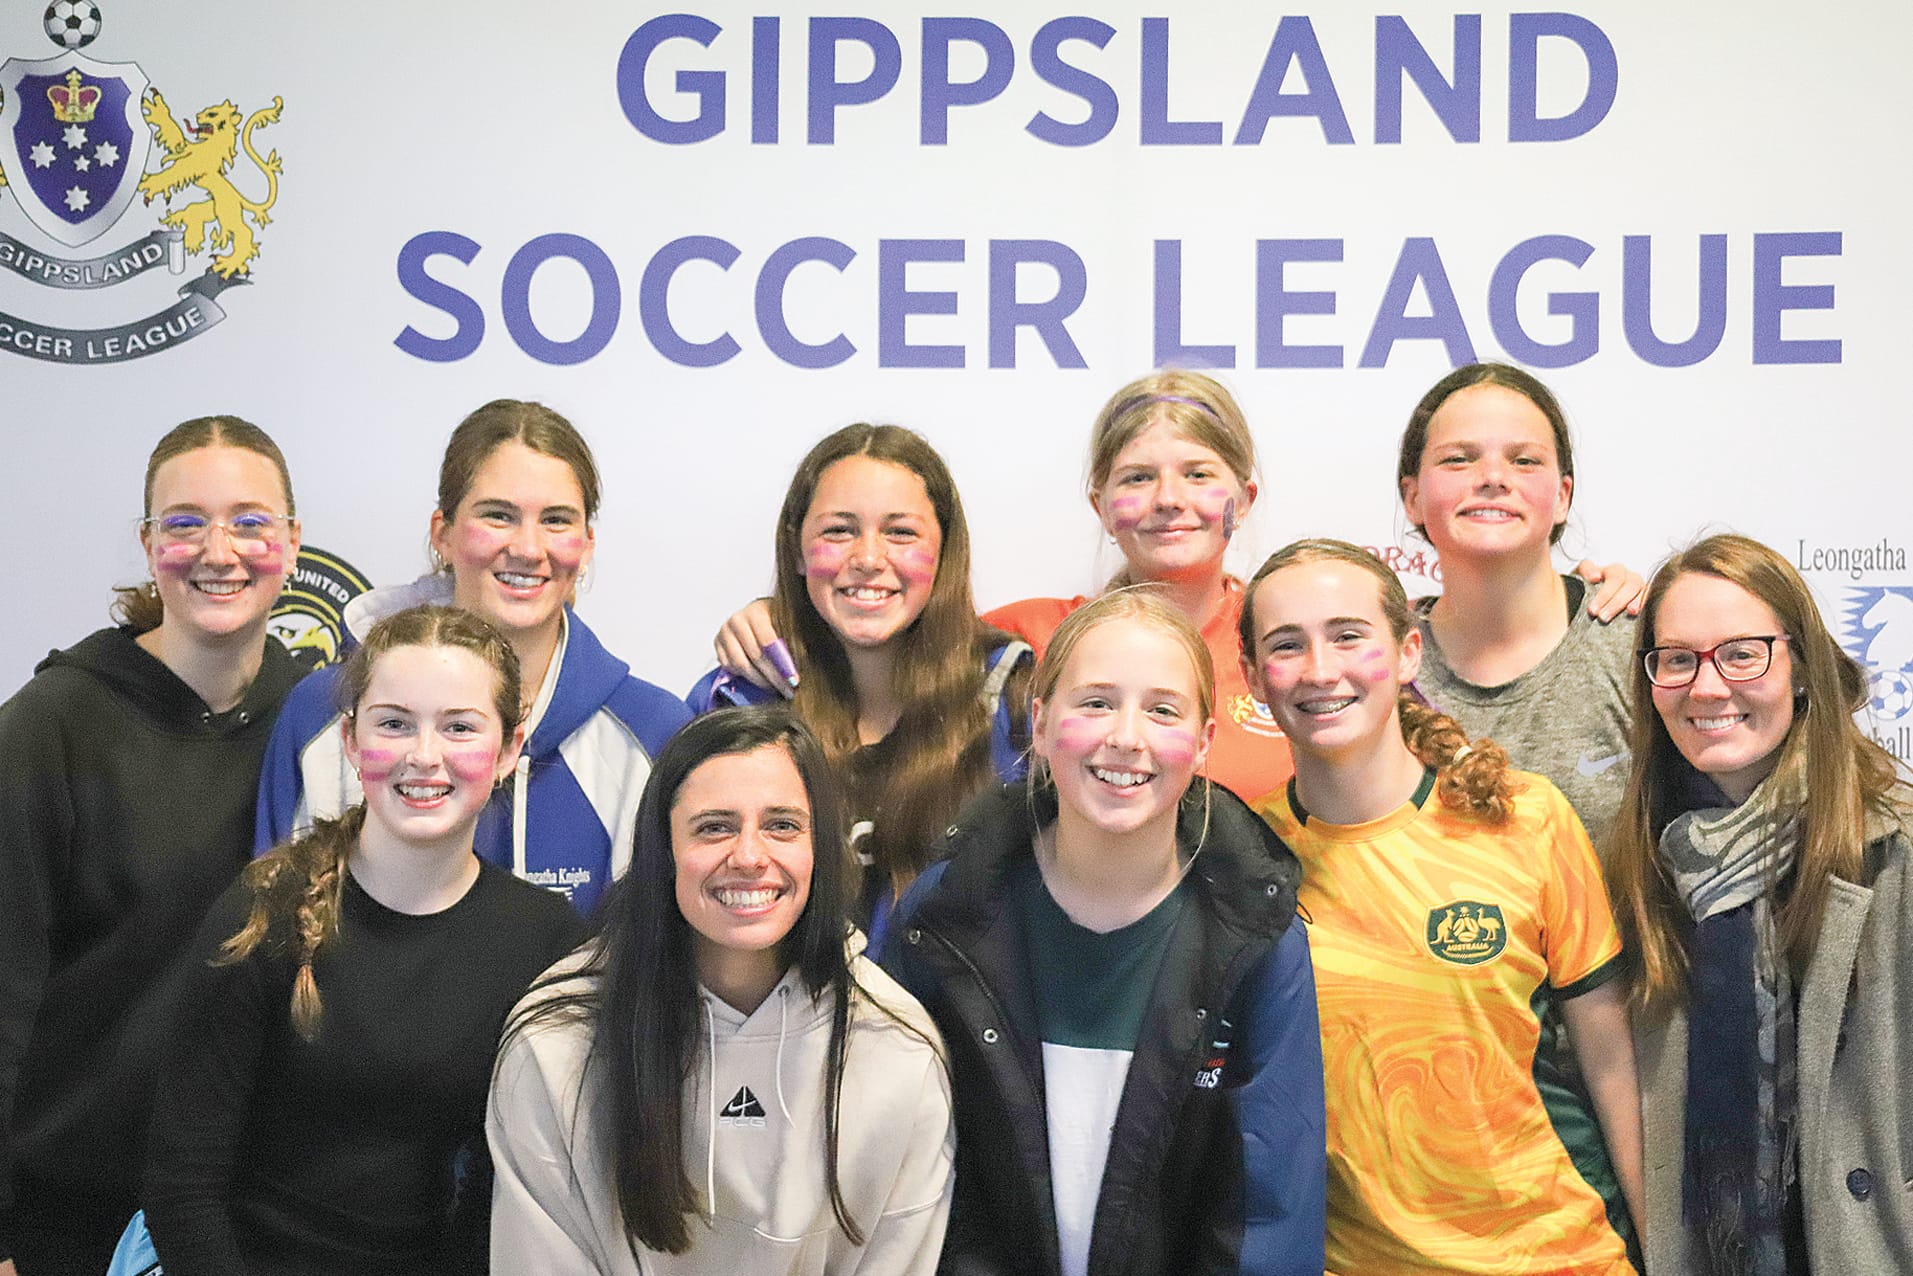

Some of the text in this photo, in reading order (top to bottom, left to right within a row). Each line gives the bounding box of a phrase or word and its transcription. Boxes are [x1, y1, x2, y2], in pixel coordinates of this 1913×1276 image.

[617, 14, 1618, 146] GIPPSLAND
[0, 242, 163, 284] GIPPSLAND
[393, 231, 1842, 368] SOCCER LEAGUE
[87, 307, 205, 359] LEAGUE
[1798, 538, 1907, 580] Leongatha
[292, 567, 350, 604] UNITED
[558, 866, 591, 888] Knights
[1446, 942, 1490, 951] AUSTRALIA
